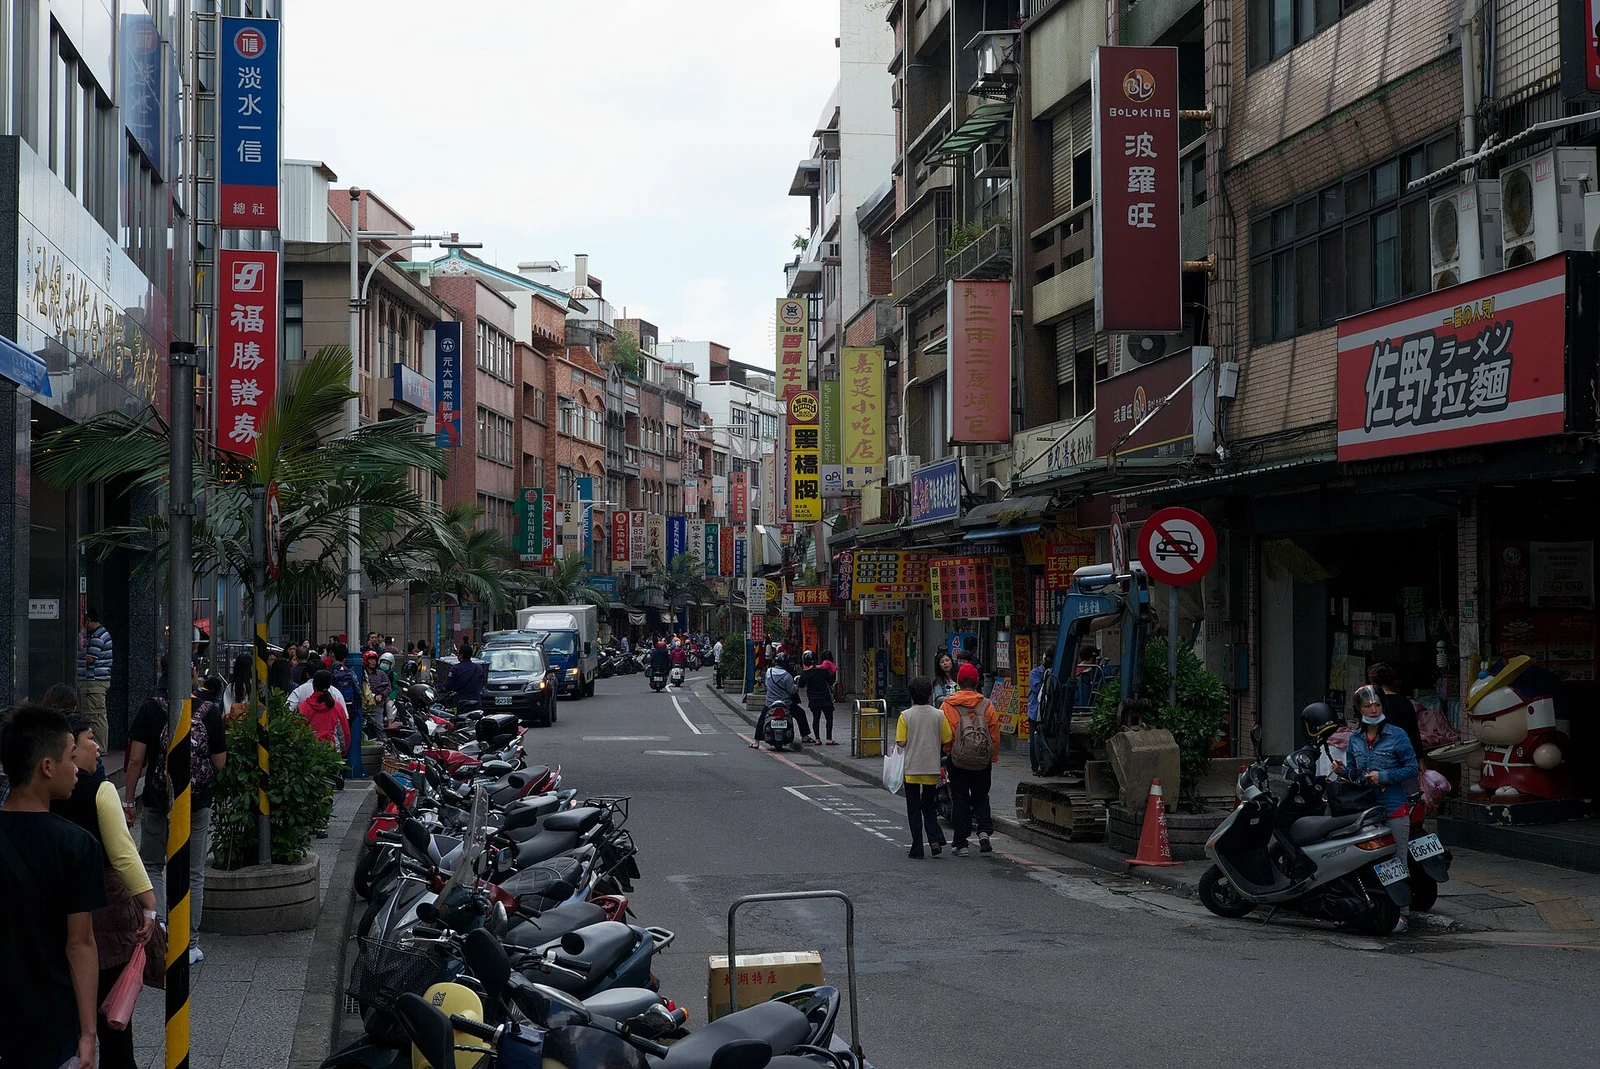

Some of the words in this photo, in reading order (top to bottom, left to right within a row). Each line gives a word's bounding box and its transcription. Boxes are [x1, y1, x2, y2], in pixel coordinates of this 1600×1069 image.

[237, 66, 263, 164] 淡水一信
[1109, 107, 1171, 118] BOLOKING
[1124, 131, 1158, 229] 波羅旺
[232, 202, 266, 216] 總社
[229, 303, 266, 443] 福勝證券
[1440, 326, 1512, 369] ラーメン
[1365, 336, 1436, 428] 佐野
[794, 429, 819, 500] 黑橋牌
[824, 444, 832, 462] Fiber
[1411, 840, 1443, 858] 836-KVL
